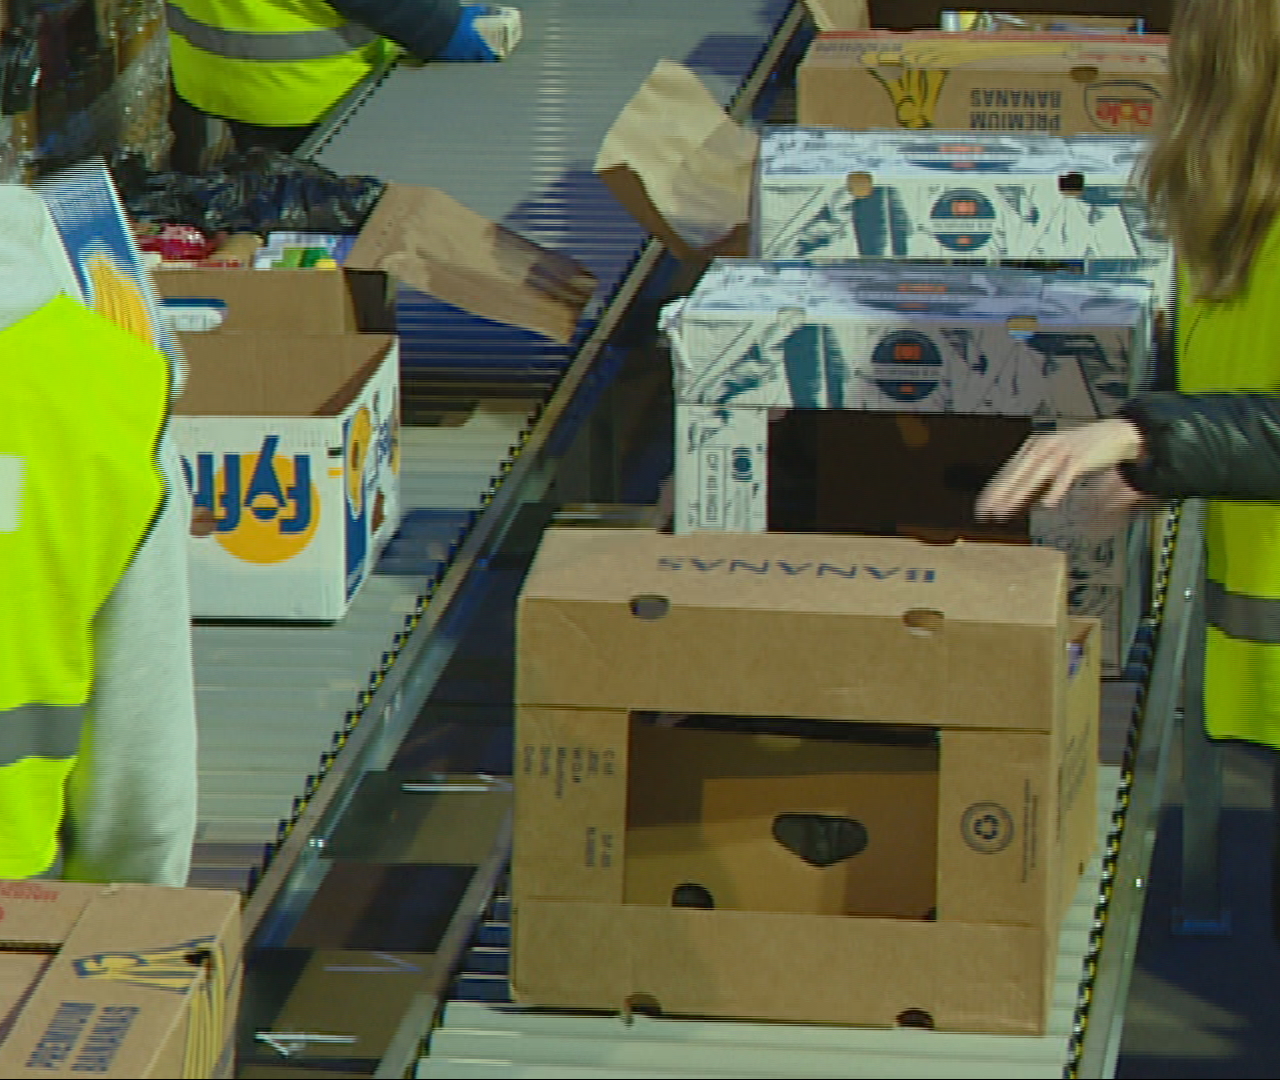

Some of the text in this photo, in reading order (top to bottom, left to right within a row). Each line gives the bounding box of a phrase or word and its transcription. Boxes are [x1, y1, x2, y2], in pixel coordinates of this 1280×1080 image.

[969, 89, 1060, 108] BANANAS
[969, 111, 1060, 130] PREMIUM
[1095, 101, 1151, 125] Dole
[181, 435, 311, 534] fyff
[657, 557, 937, 584] BANANAS
